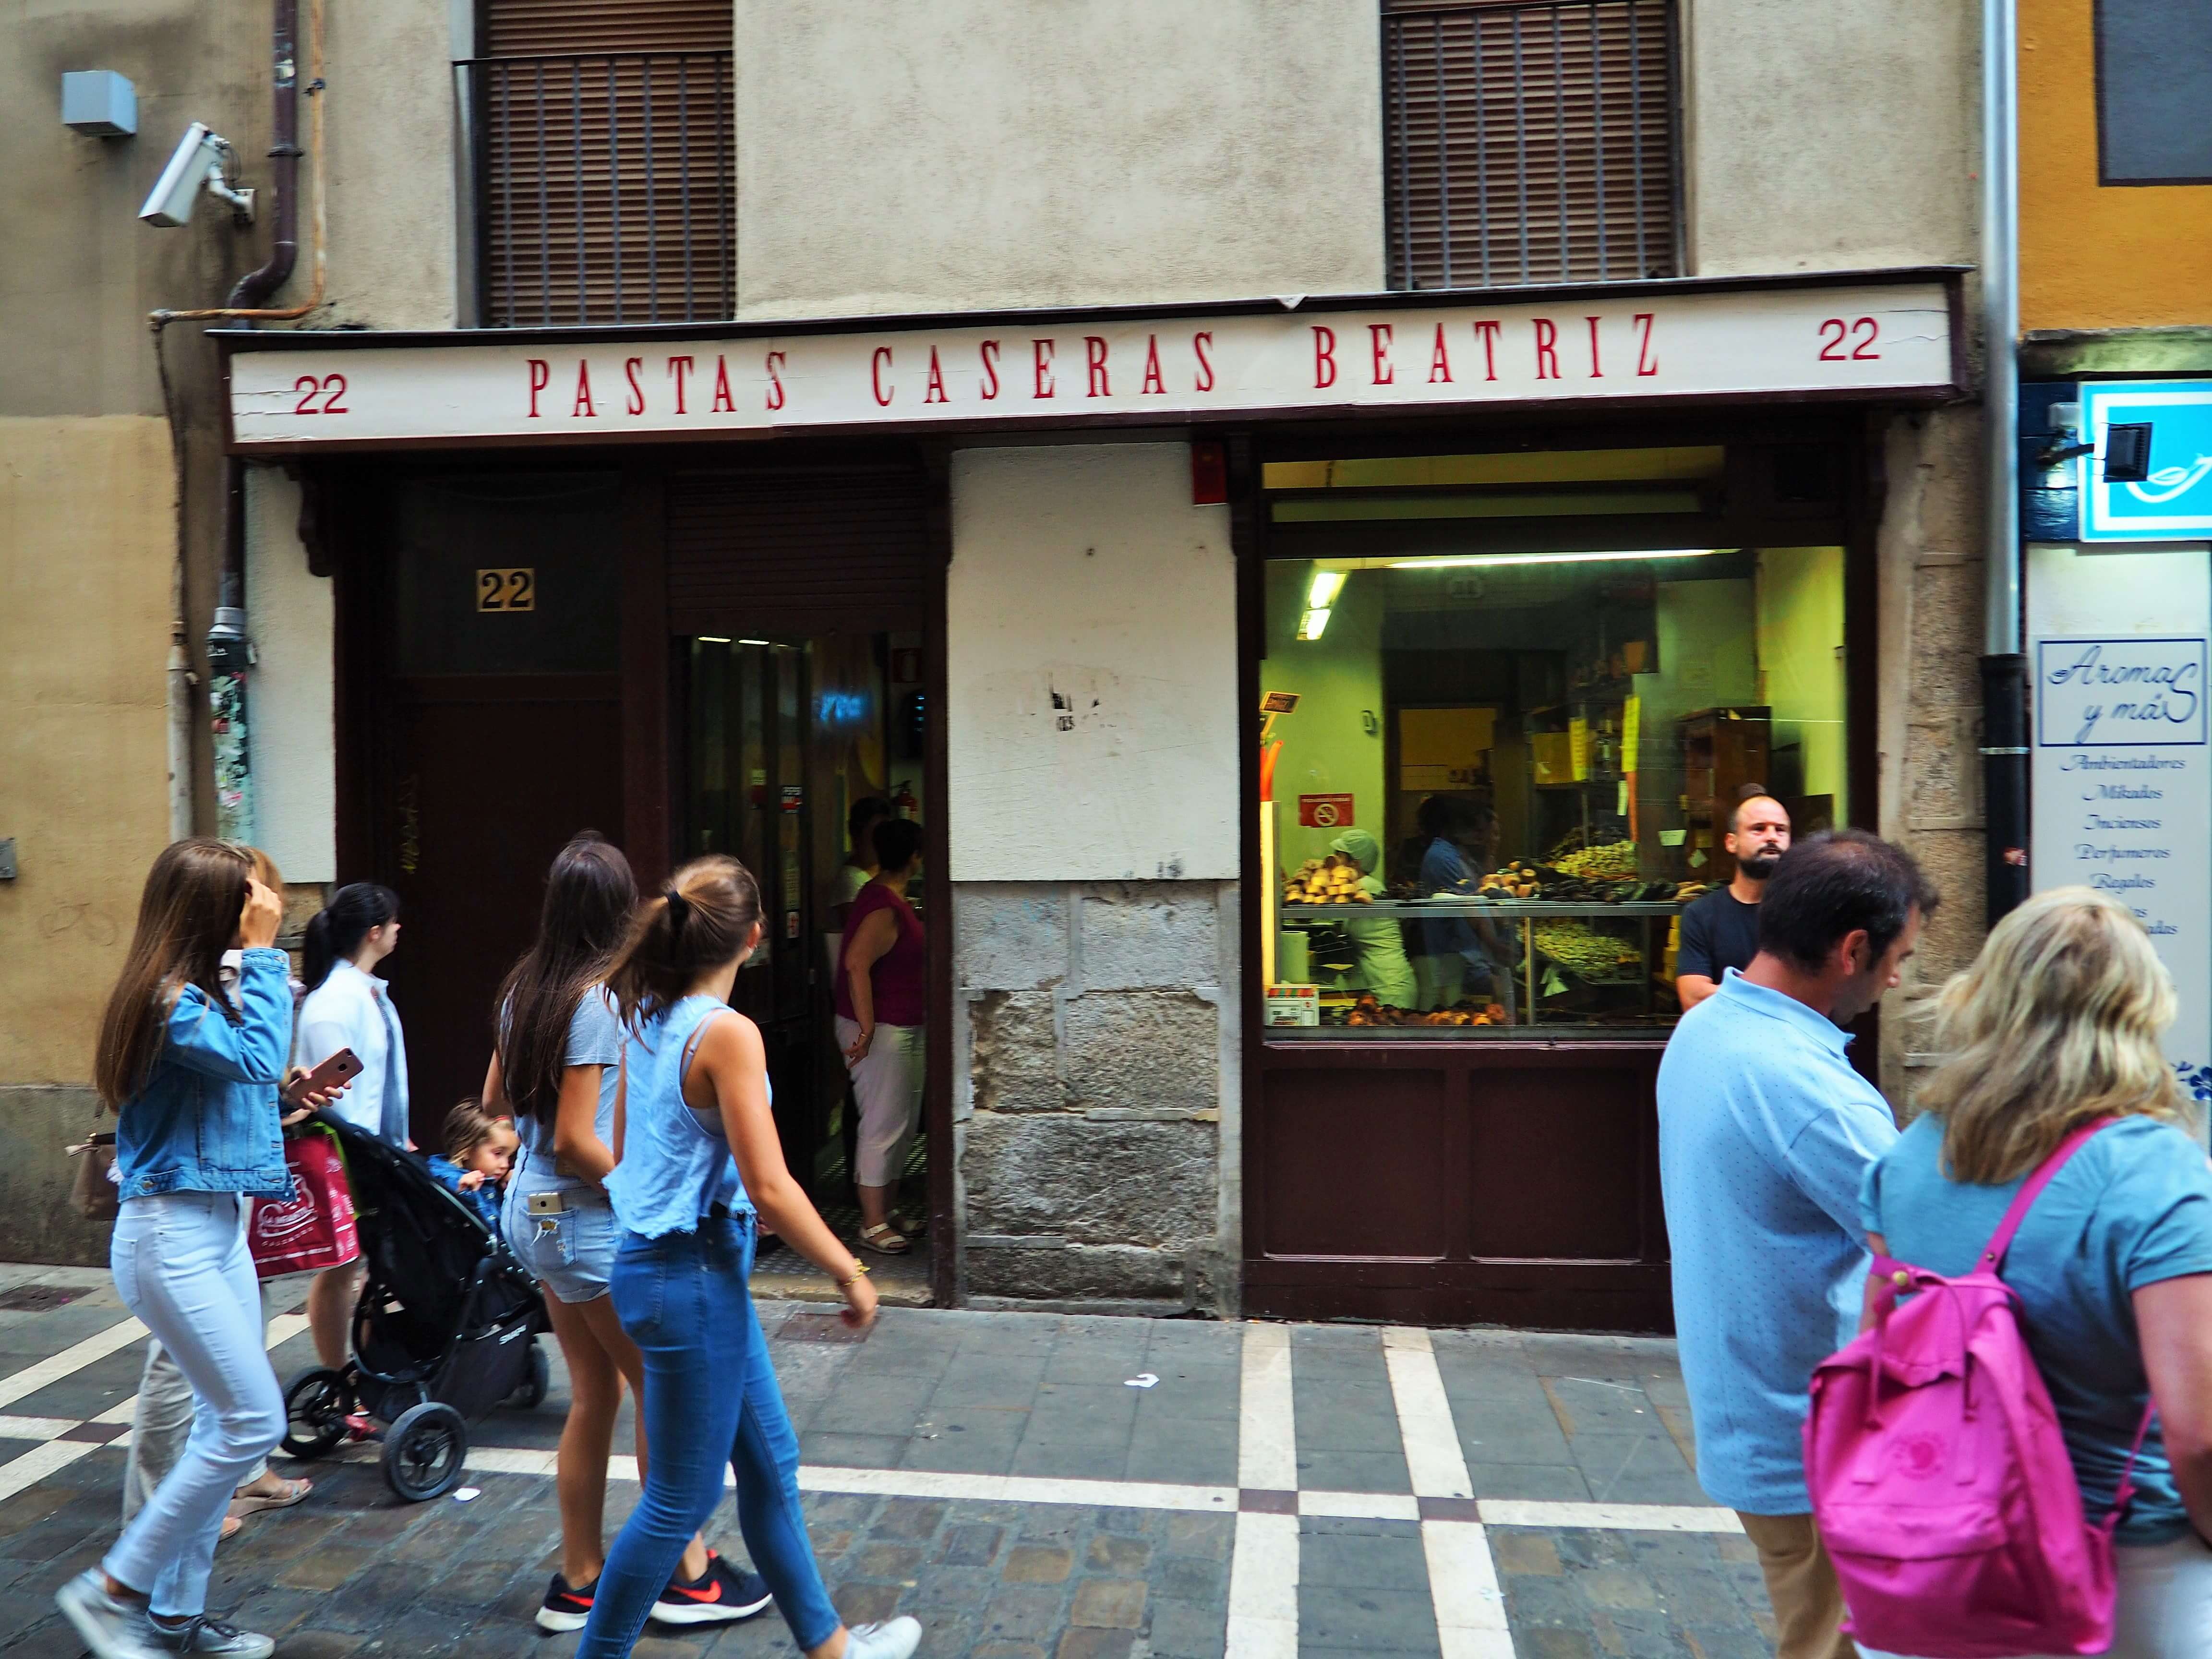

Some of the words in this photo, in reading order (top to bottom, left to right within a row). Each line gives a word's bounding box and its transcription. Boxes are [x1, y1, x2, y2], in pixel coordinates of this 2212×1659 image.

[1819, 317, 1881, 361] 22
[527, 351, 786, 418] PASTAS
[871, 332, 1215, 406] CASERAS
[1311, 313, 1659, 389] BEATRIZ
[293, 373, 349, 415] 22
[482, 571, 531, 608] 22
[2074, 705, 2103, 744] y
[2059, 754, 2187, 771] Ambientadores
[2081, 784, 2164, 801] Mikados
[2083, 814, 2163, 830] Inciensos
[2090, 872, 2157, 894] Regalos
